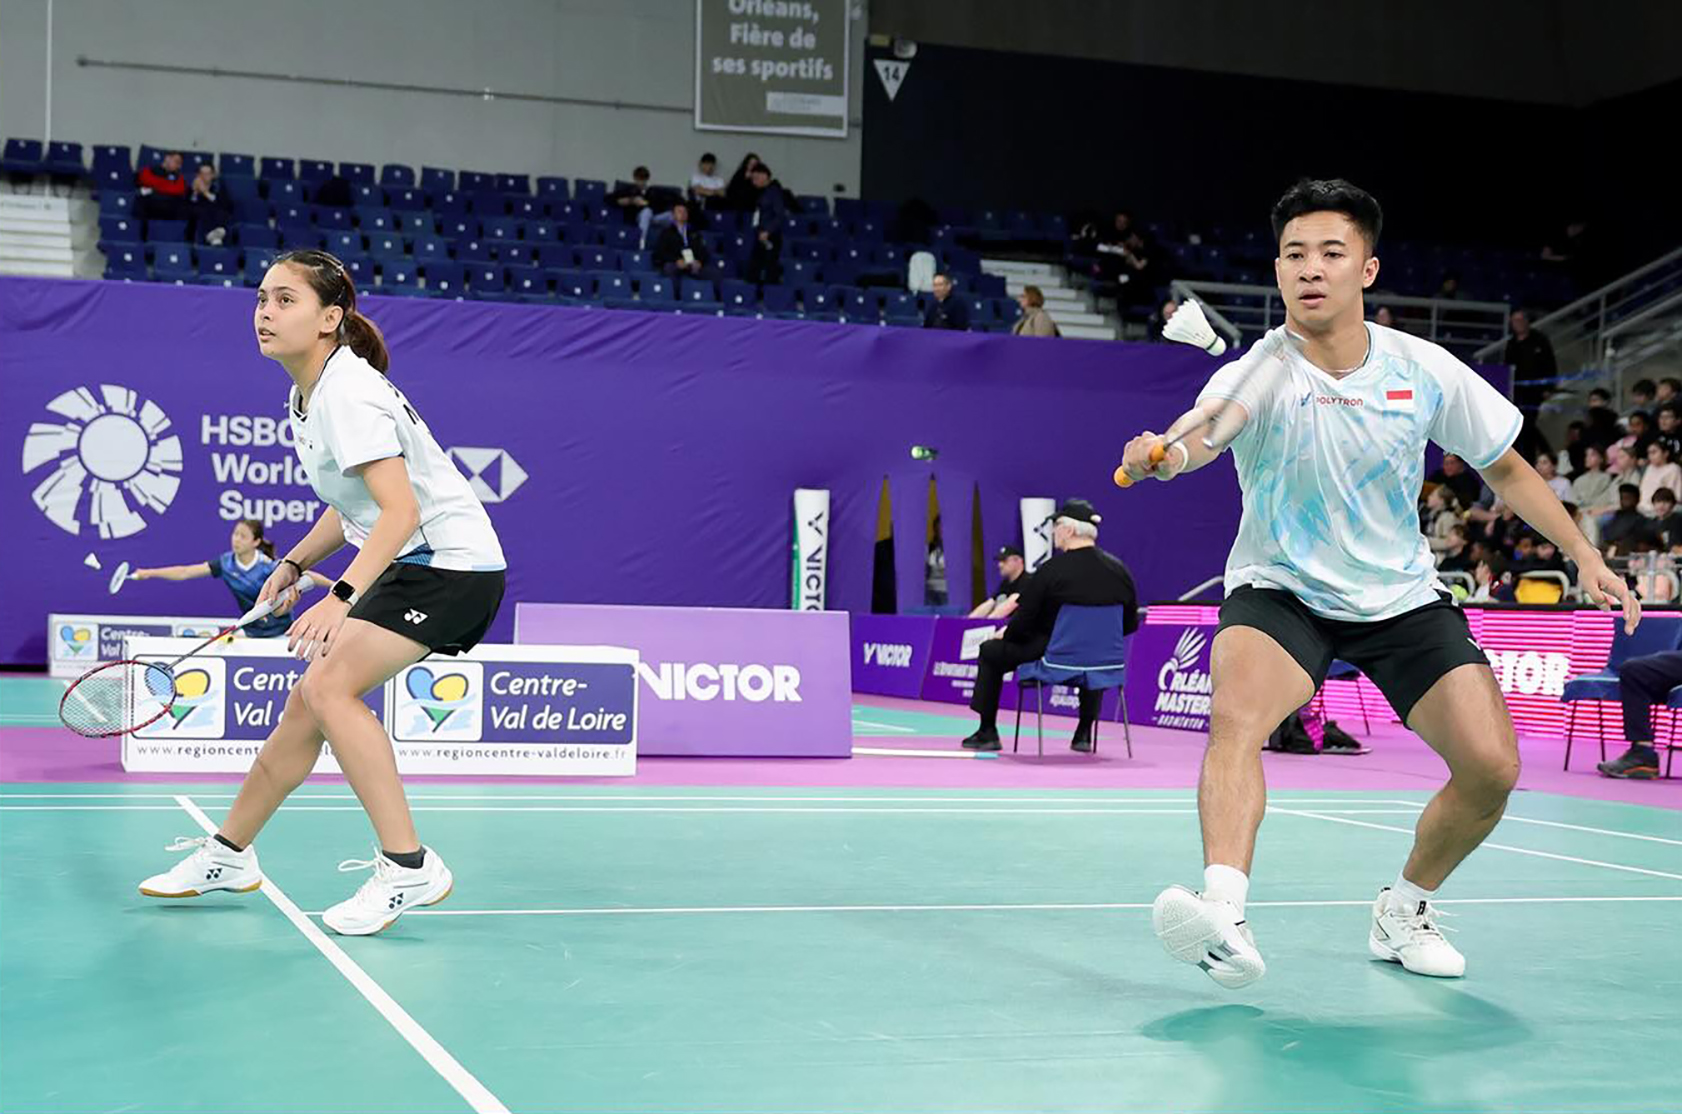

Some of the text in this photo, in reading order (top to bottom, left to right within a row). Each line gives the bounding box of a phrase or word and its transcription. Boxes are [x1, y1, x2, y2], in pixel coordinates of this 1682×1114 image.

[731, 23, 816, 49] Fière de
[713, 57, 833, 82] ses sportifs
[885, 66, 900, 81] 14
[219, 490, 320, 528] Super
[490, 671, 588, 696] Centre-
[234, 700, 273, 726] Val
[1154, 691, 1212, 716] MASTER
[491, 704, 627, 730] Val de Loire
[398, 746, 626, 760] www.regioncentre-valdeloire.fr
